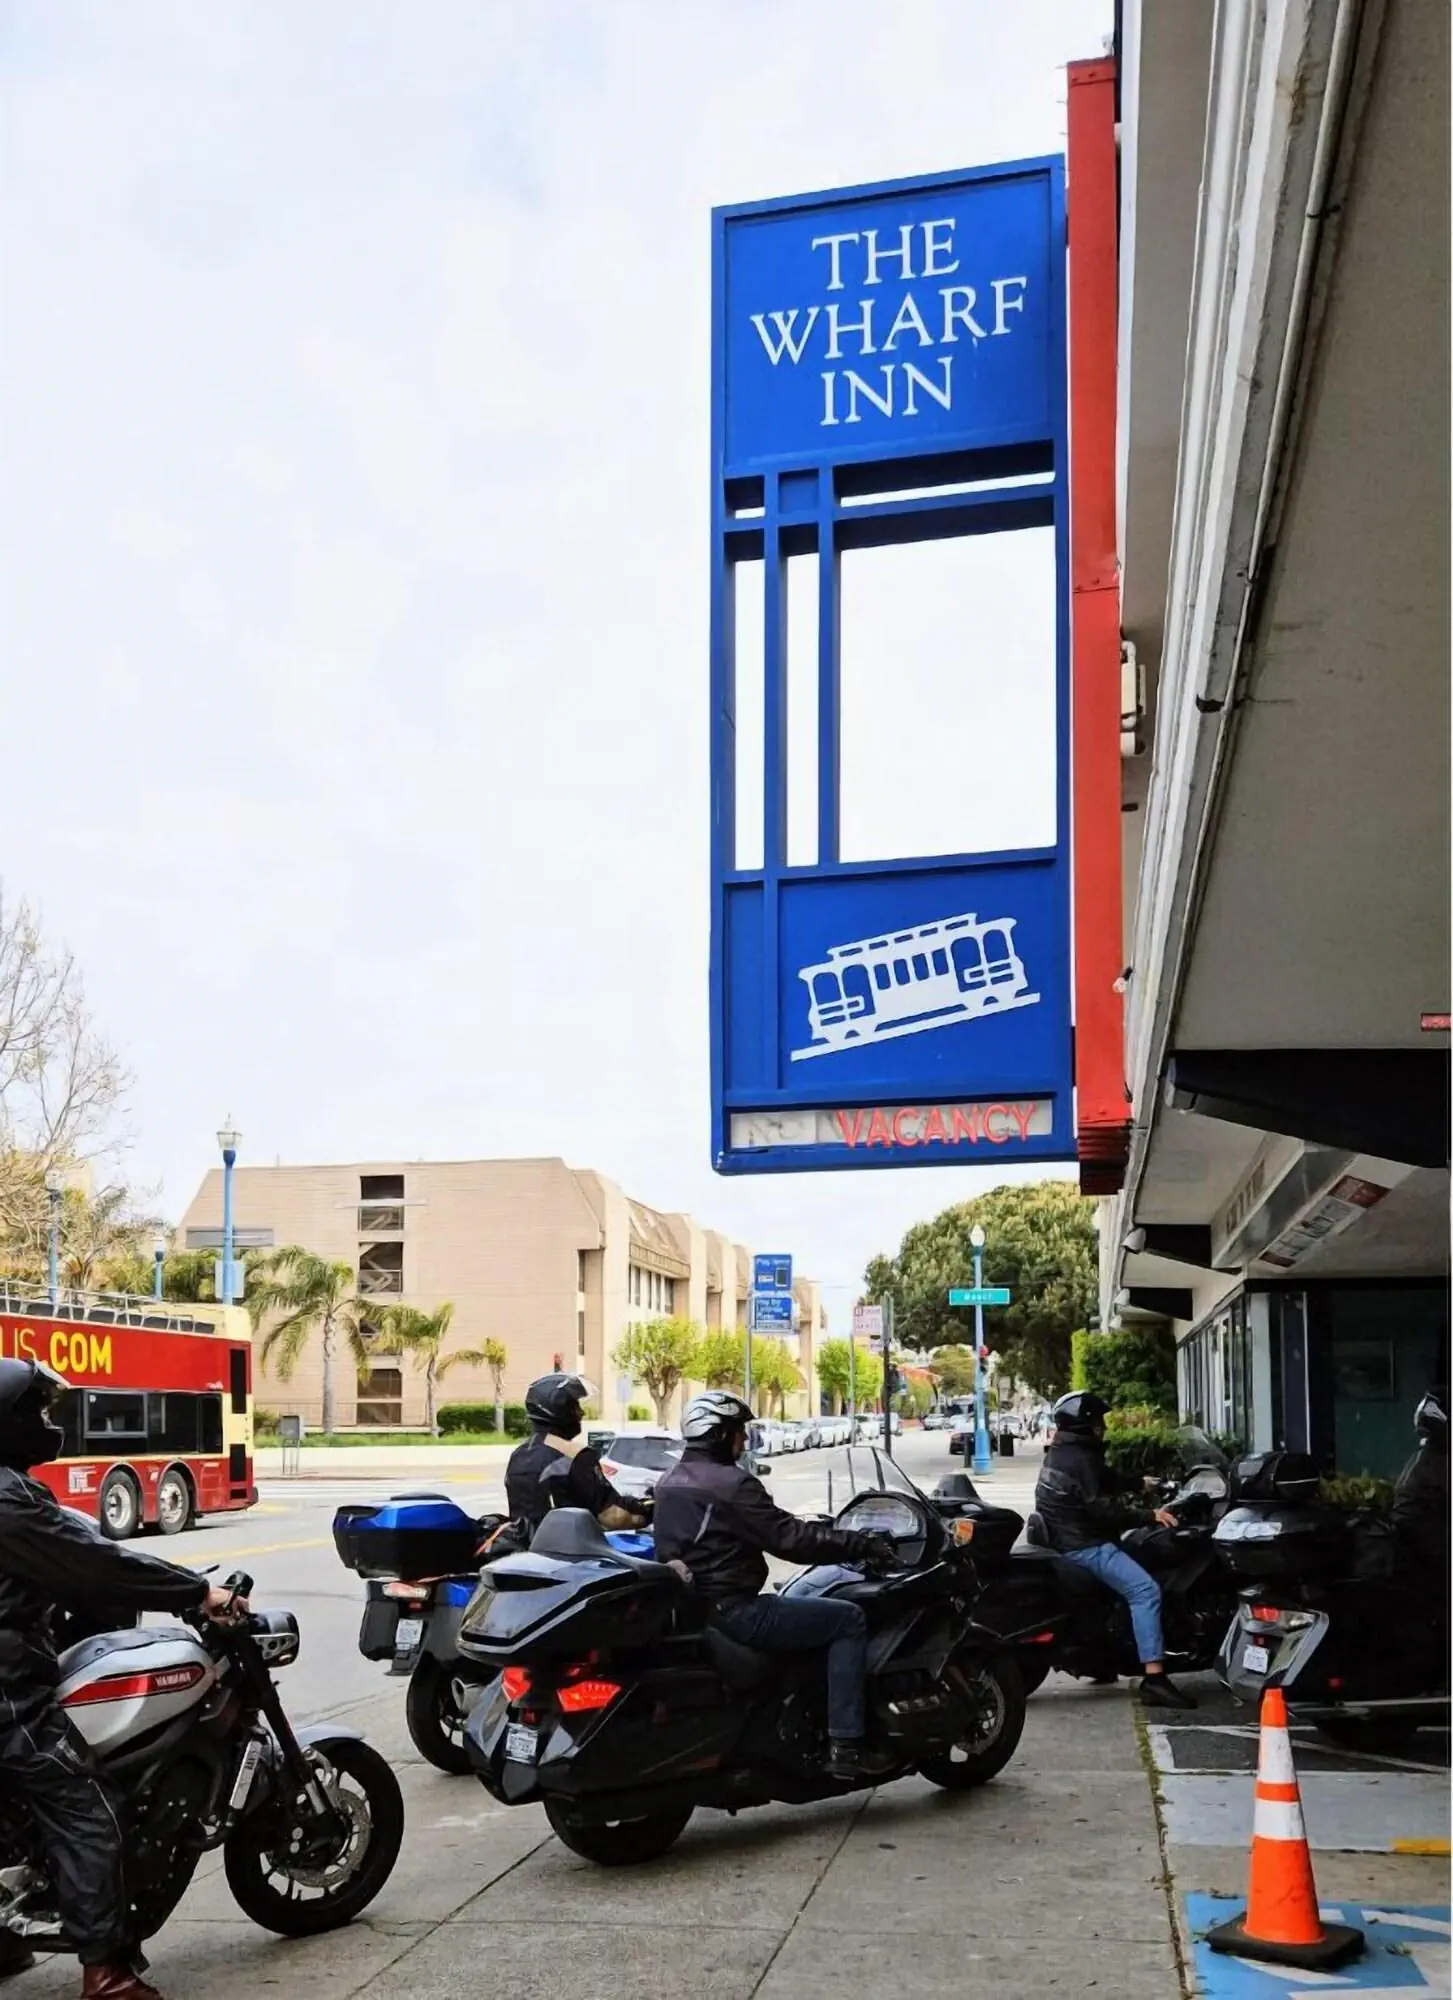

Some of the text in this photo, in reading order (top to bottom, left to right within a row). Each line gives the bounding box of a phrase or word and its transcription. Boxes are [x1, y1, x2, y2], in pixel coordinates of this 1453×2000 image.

[811, 218, 960, 291] THE
[750, 276, 1028, 366] WHARF
[820, 356, 953, 426] INN
[835, 1102, 1037, 1148] VACANCY
